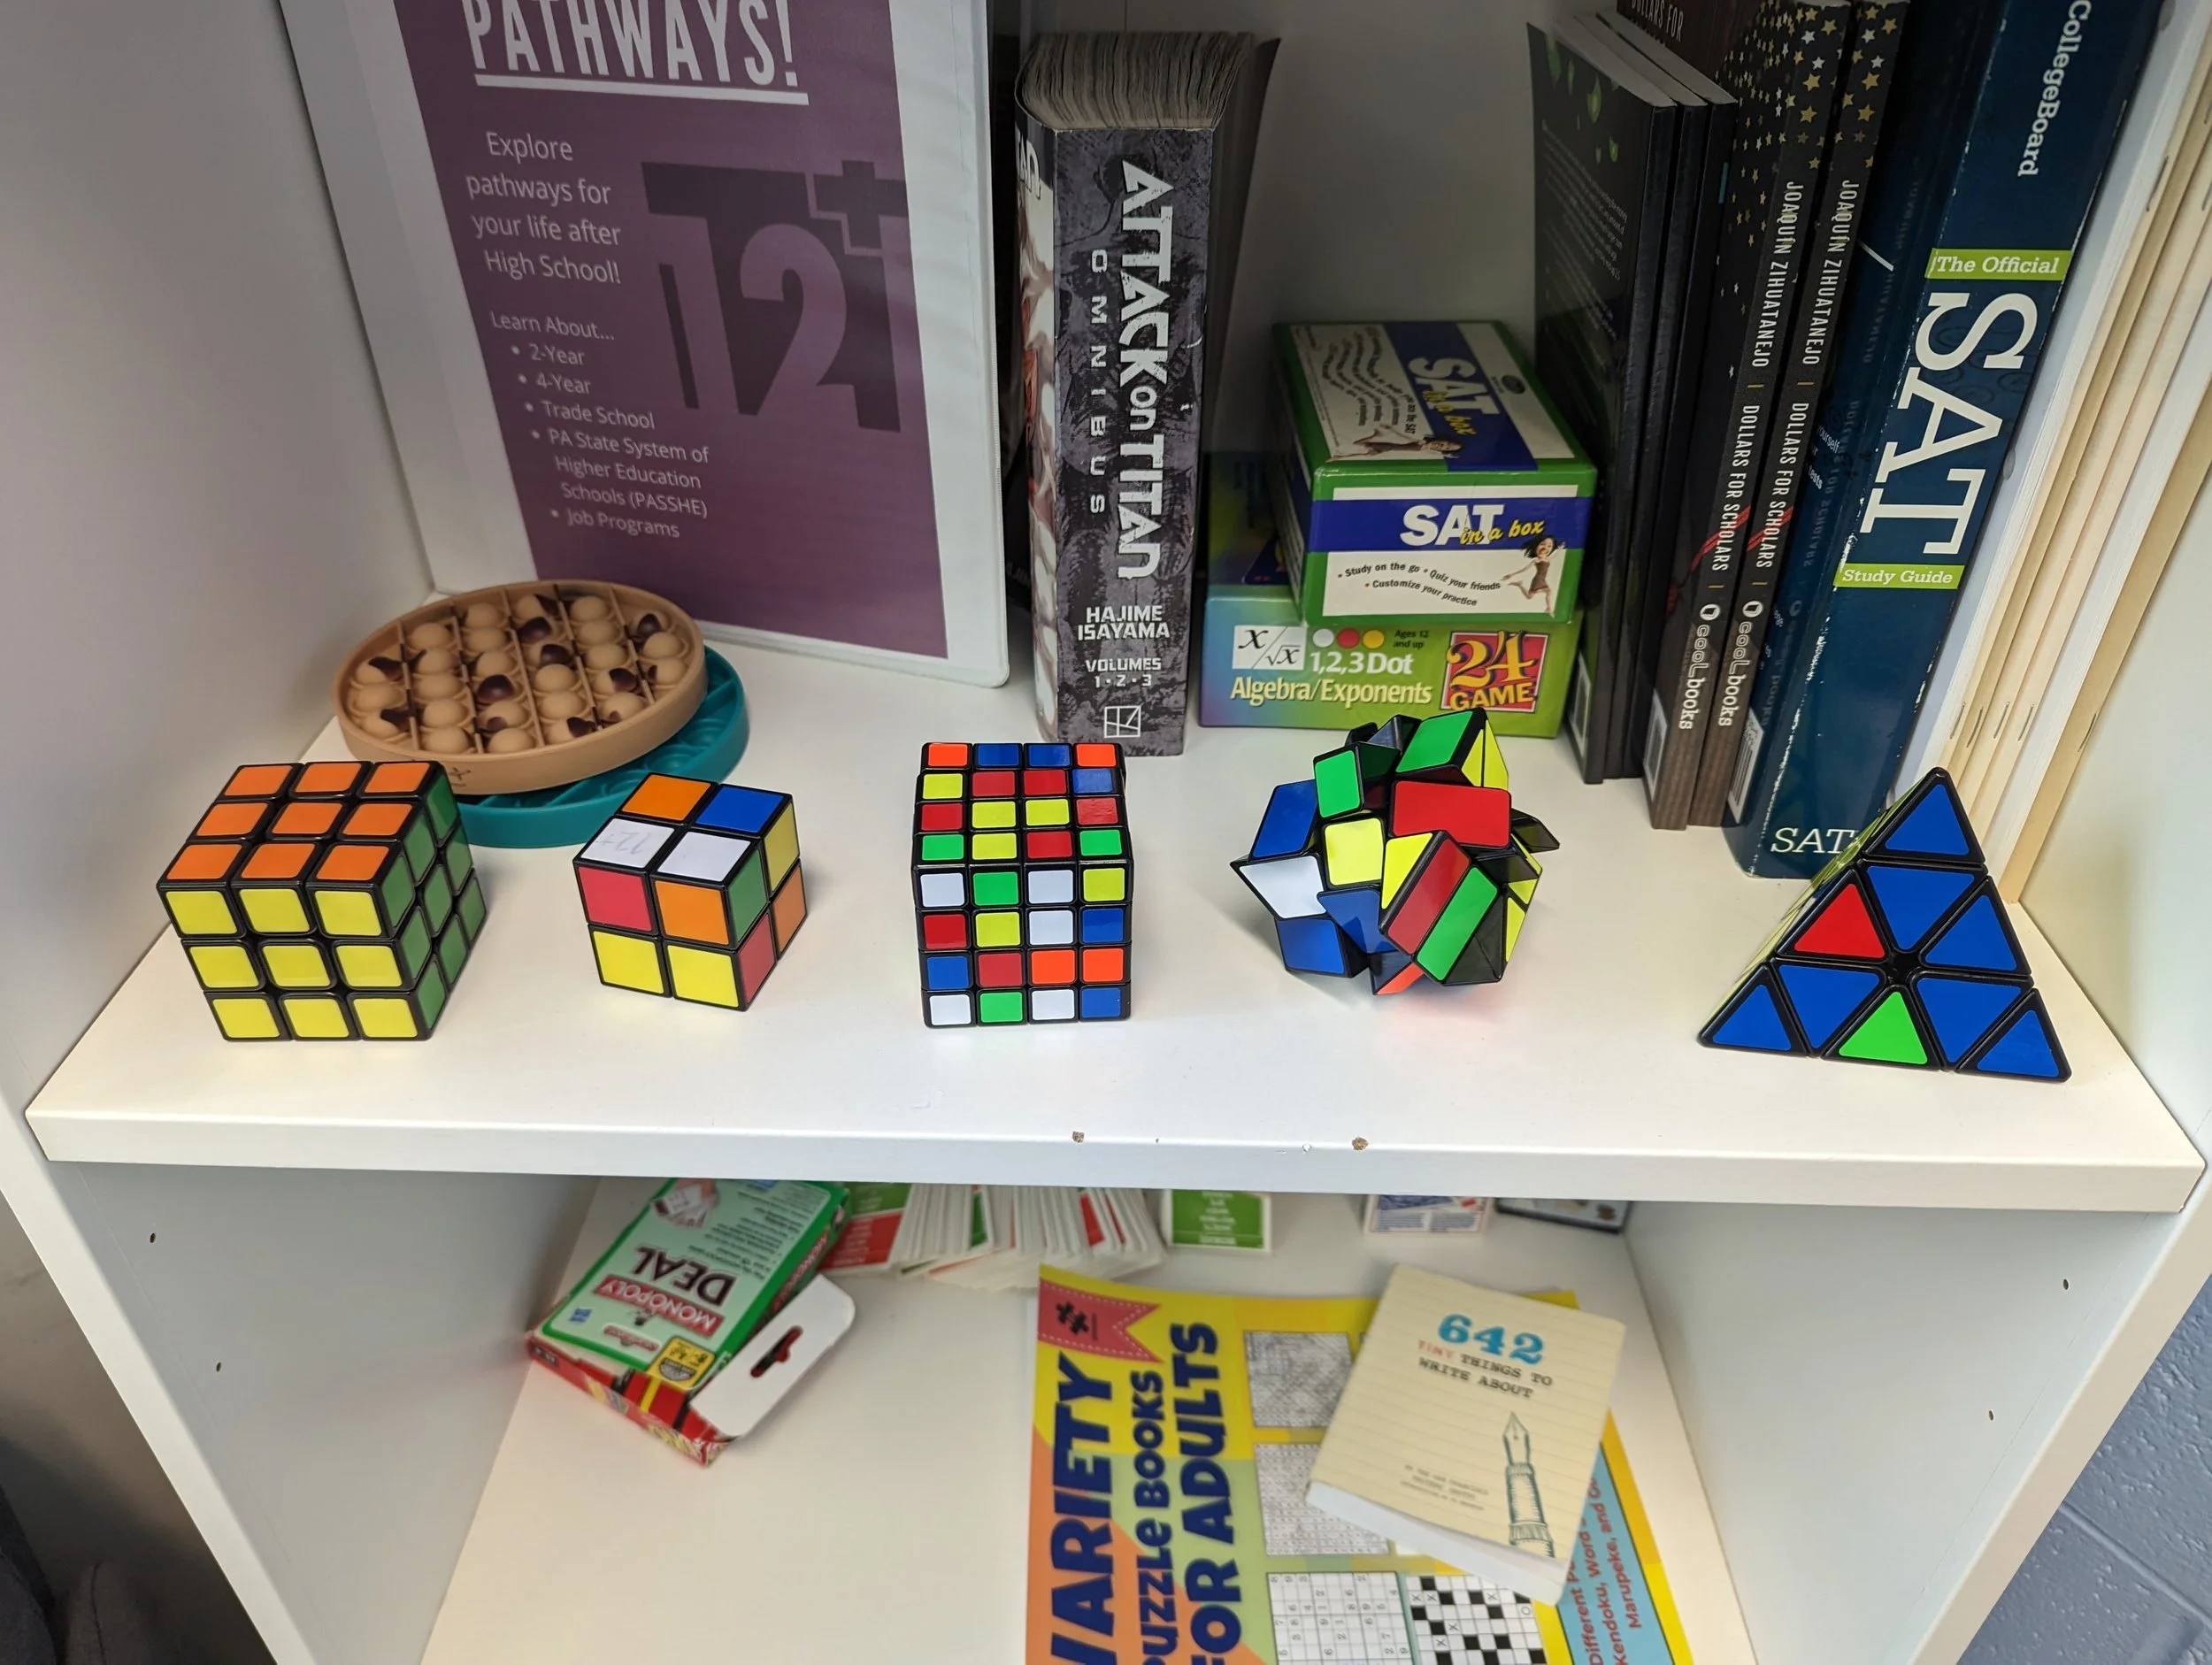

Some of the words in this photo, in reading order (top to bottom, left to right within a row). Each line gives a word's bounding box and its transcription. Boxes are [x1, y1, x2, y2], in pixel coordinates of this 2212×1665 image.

[1666, 4, 1685, 42] FOR
[462, 0, 798, 87] PATHWAYS!
[2017, 0, 2093, 177] CollegeBoard
[487, 132, 573, 164] Explore
[466, 173, 573, 207] pathways
[578, 179, 611, 205] for
[472, 215, 520, 239] your
[527, 215, 563, 241] life
[569, 219, 621, 245] after
[484, 249, 535, 280] High
[540, 255, 622, 284] School!
[1118, 160, 1174, 387] ATTACK
[1936, 256, 1976, 274] The
[1983, 254, 2061, 275] Official
[490, 311, 541, 333] Learn
[546, 316, 615, 341] About...
[1751, 261, 1789, 367] ZIHUATANEJO
[1802, 259, 1843, 364] ZIHUATANEJO
[529, 343, 586, 365] 2-Year
[536, 373, 591, 395] 4-Year
[1088, 249, 1109, 515] OMNIBUS
[1408, 357, 1501, 416] SAT
[541, 400, 594, 423] Trade
[596, 406, 656, 430] School
[1125, 386, 1157, 431] on
[1863, 292, 2038, 556] SAT
[547, 427, 573, 447] PA
[576, 431, 620, 452] State
[624, 437, 687, 463] System
[691, 445, 710, 464] of
[1732, 404, 1760, 467] DOLLARS
[1780, 403, 1810, 464] DOLLARS
[555, 456, 612, 479] Higher
[615, 463, 703, 489] Education
[1727, 472, 1747, 499] FOR
[1771, 470, 1794, 496] FOR
[560, 482, 626, 507] Schools
[629, 490, 709, 519] (PASSHE)
[1116, 434, 1164, 581] TITAN
[566, 508, 595, 527] Job
[597, 511, 680, 538] Programs
[1399, 503, 1504, 547] SAT
[1460, 526, 1484, 545] in
[1488, 527, 1503, 541] a
[1509, 518, 1545, 538] box
[1711, 503, 1740, 572] SCHOLARS
[1755, 500, 1785, 569] SCHOLARS
[1344, 564, 1372, 578] Study
[1374, 563, 1387, 572] on
[1390, 562, 1406, 572] the
[1408, 564, 1421, 574] go
[1429, 569, 1448, 584] Quiz
[1449, 577, 1468, 590] your
[1470, 579, 1502, 592] friends
[1372, 579, 1421, 591] Customize
[1422, 584, 1441, 598] your
[1441, 590, 1478, 608] practice
[1843, 568, 1900, 587] Study
[1903, 569, 1955, 587] Guide
[1077, 623, 1170, 641] ISAYAMA
[1086, 605, 1164, 624] HAJIME
[1393, 639, 1411, 648] and
[1412, 641, 1425, 650] up
[1394, 629, 1415, 641] Ages
[1417, 629, 1430, 639] 12
[1085, 657, 1162, 673] VOLUMES
[1367, 653, 1414, 675] Dot
[1447, 629, 1540, 690] 24
[1231, 678, 1433, 708] Algebra/Exponents
[1450, 681, 1538, 711] GAME
[1770, 827, 1856, 855] SAT
[633, 1246, 738, 1307] DEAL
[599, 1277, 720, 1331] MONOPOLY
[1439, 1313, 1545, 1365] 642
[1417, 1339, 1456, 1360] TINY
[1461, 1354, 1523, 1378] THINGS
[1531, 1371, 1554, 1386] TO
[1418, 1357, 1471, 1381] WRITE
[1478, 1375, 1534, 1400] ABOUT
[1130, 1370, 1171, 1509] BOOKS
[1169, 1322, 1234, 1545] ADULTS
[1590, 1502, 1613, 1533] and
[1578, 1531, 1601, 1578] Word
[1134, 1519, 1179, 1665] UZZLe
[1606, 1537, 1644, 1630] Marupeke,
[1183, 1559, 1242, 1665] OR
[1571, 1586, 1604, 1665] Different
